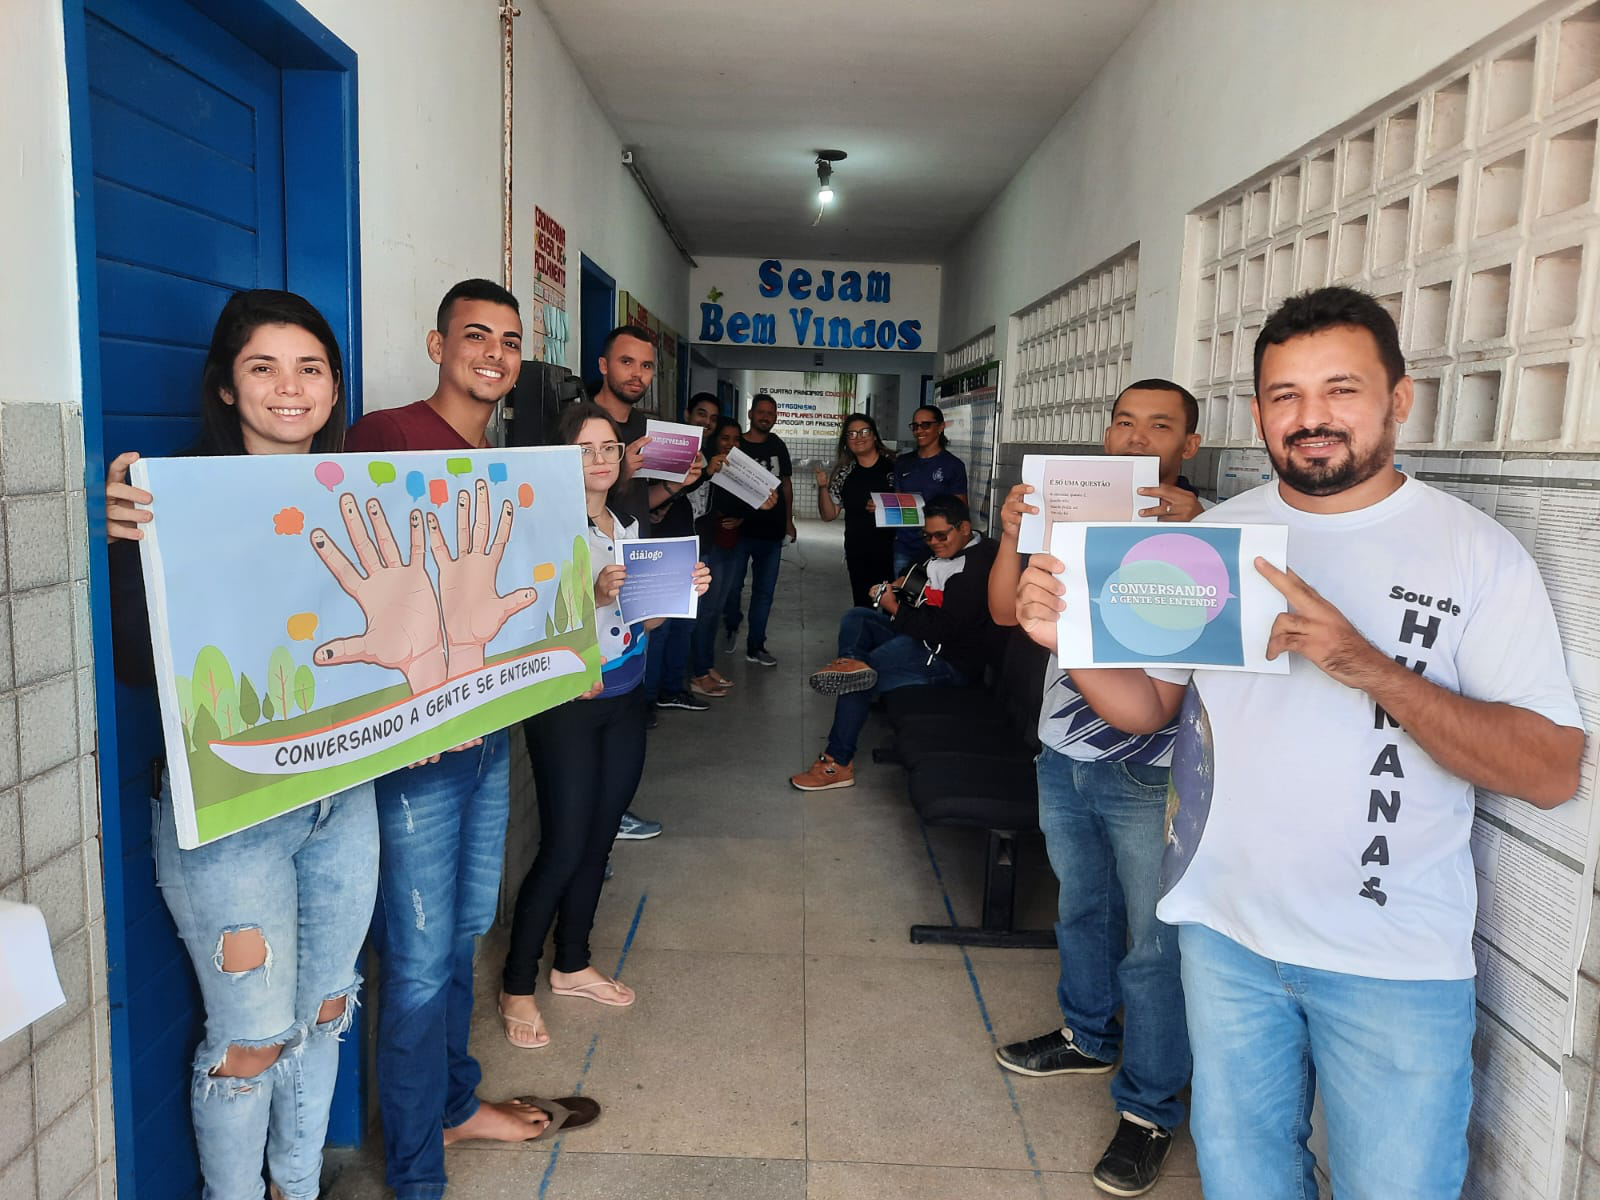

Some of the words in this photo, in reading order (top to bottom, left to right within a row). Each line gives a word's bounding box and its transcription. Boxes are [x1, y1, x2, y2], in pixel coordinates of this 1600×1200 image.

[758, 259, 891, 303] Sejam
[699, 302, 776, 345] Bem
[789, 307, 922, 350] Vindos
[1080, 480, 1111, 488] QUESTÃO
[629, 550, 663, 561] diálogo
[1109, 583, 1217, 597] CONVERSANDO
[1110, 595, 1117, 604] A
[1120, 595, 1153, 604] GENTE
[1154, 597, 1167, 605] SE
[1169, 597, 1217, 607] ENTENDE
[1437, 597, 1461, 616] de
[275, 714, 404, 767] CONVERSANDO
[410, 707, 420, 726] A
[426, 683, 471, 717] GENTE
[476, 673, 495, 694] SE
[500, 656, 551, 686] ENTENDE!
